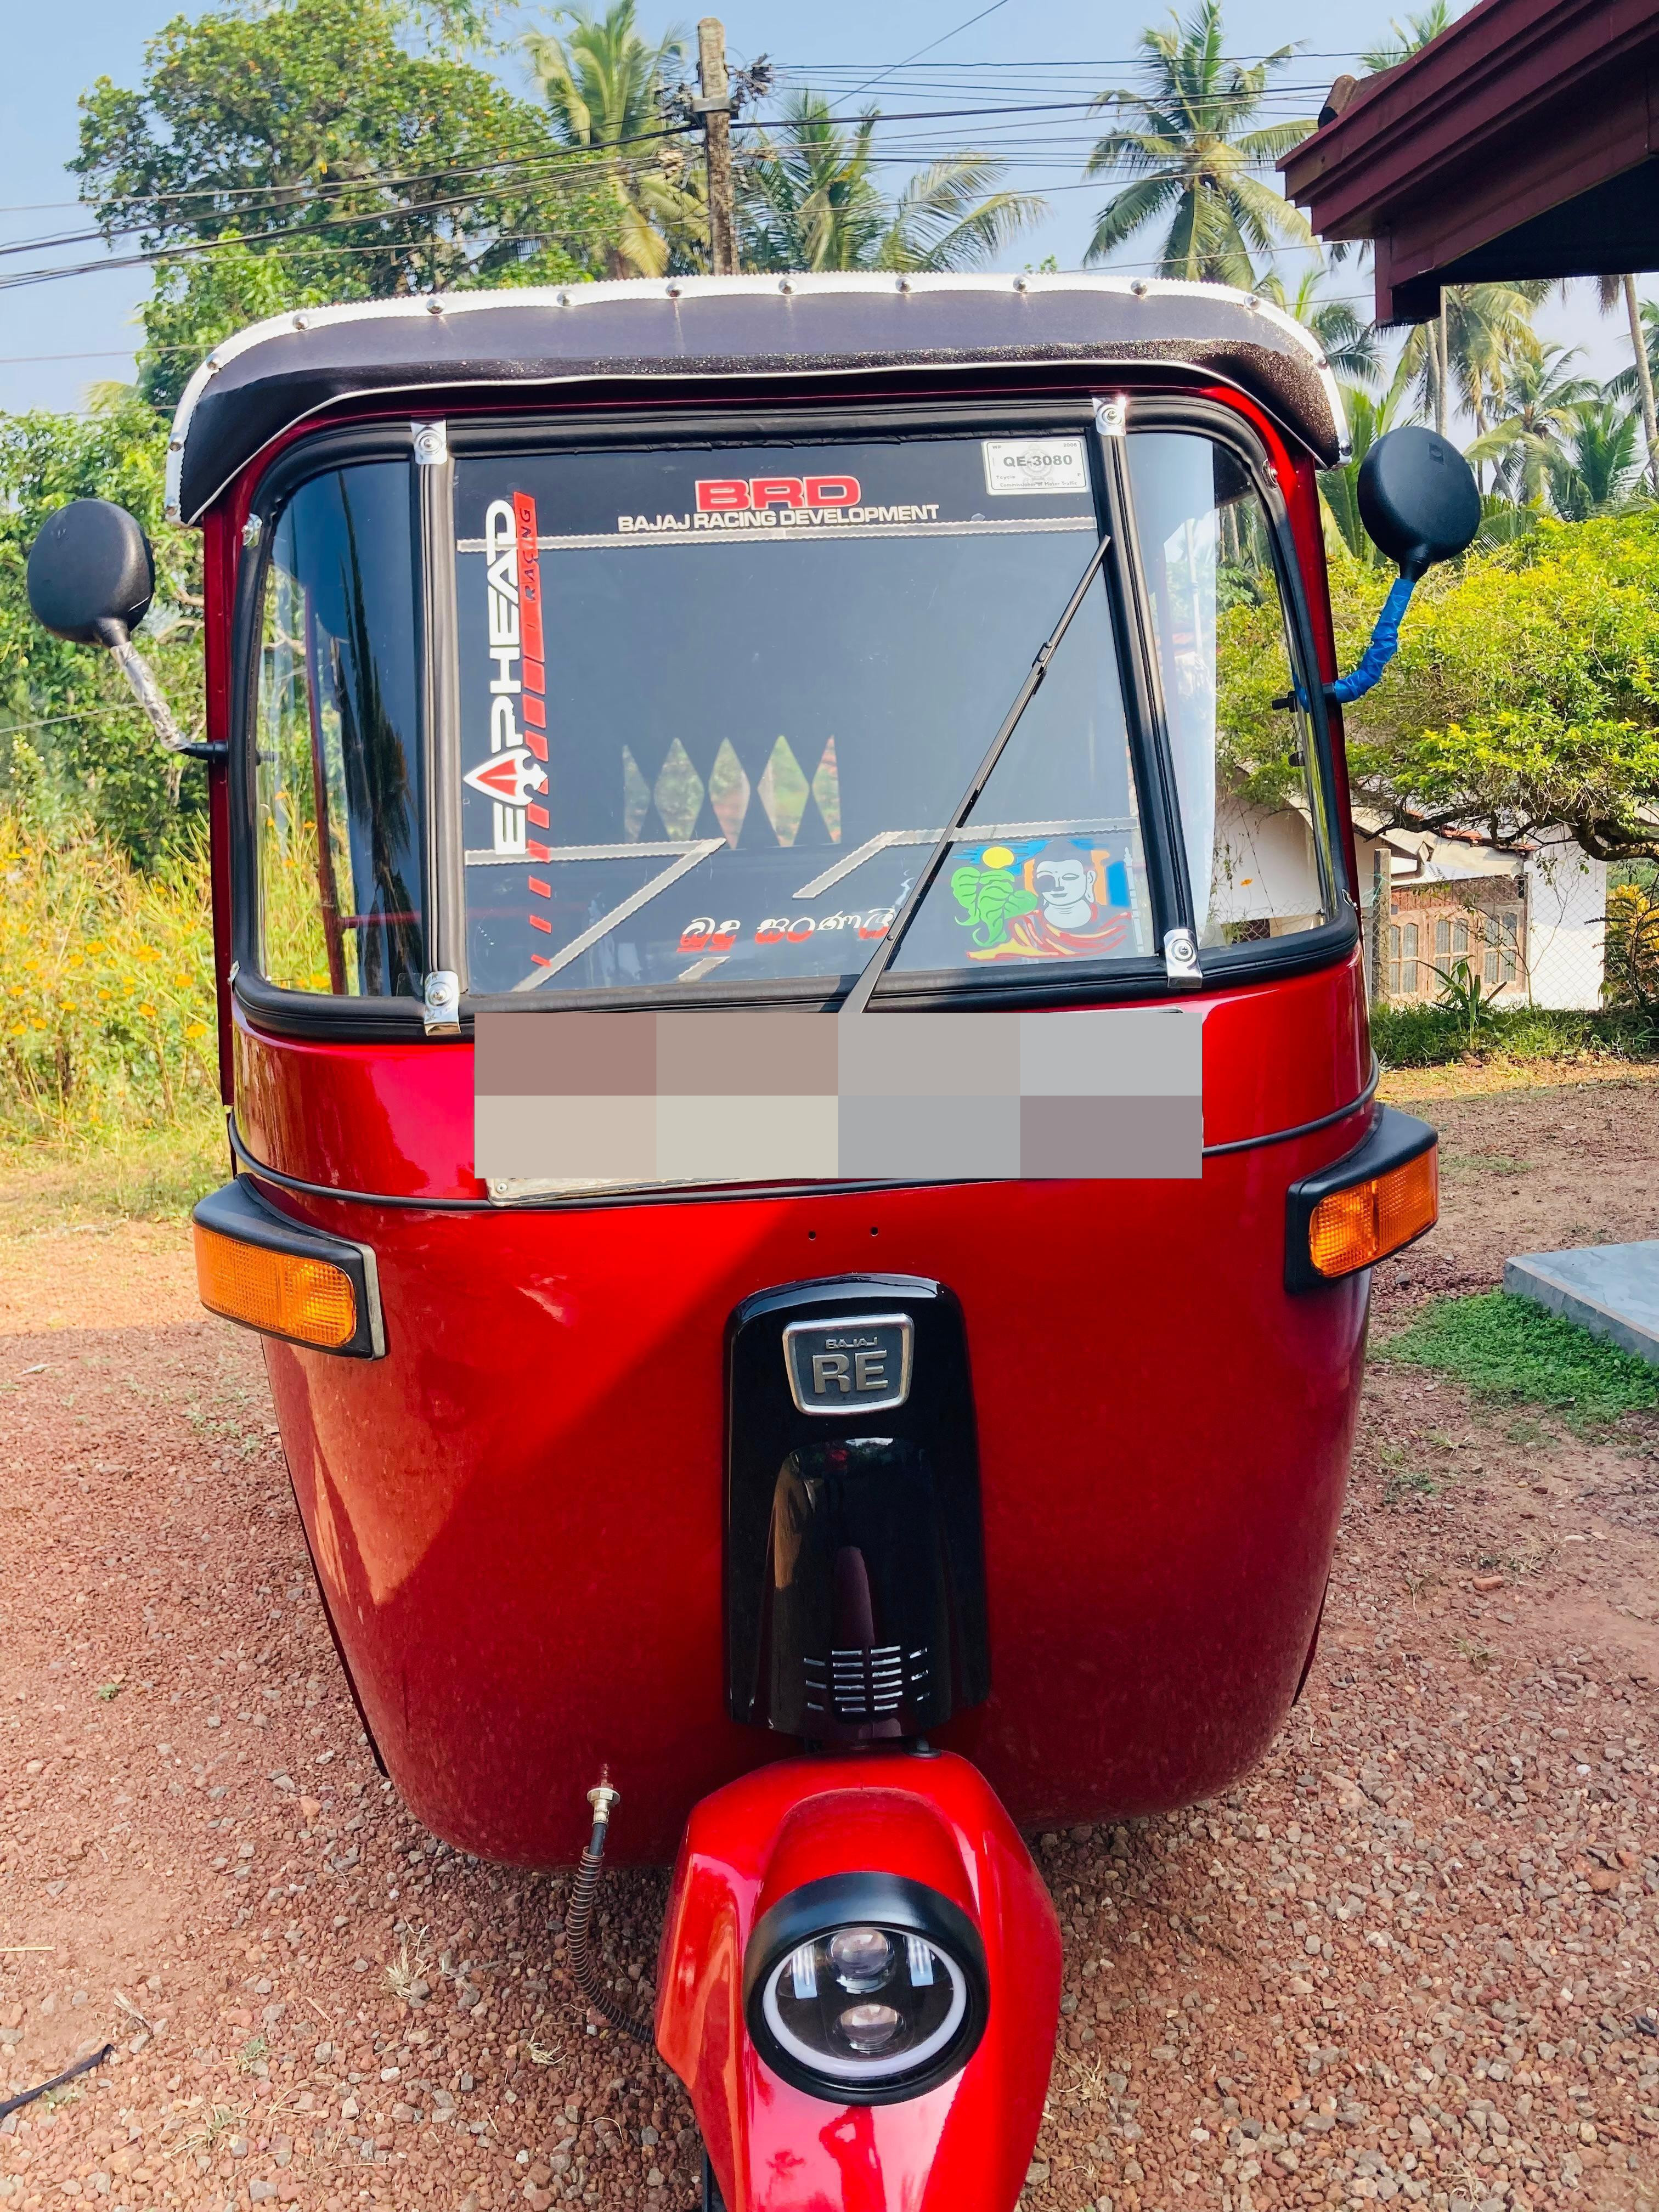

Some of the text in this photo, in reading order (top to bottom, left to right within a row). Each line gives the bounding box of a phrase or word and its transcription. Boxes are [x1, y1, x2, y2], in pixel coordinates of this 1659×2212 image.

[1003, 455, 1073, 467] QE-3080
[695, 476, 861, 512] BRD
[618, 504, 939, 532] BAJAJ RACING DEVELOPMENT
[520, 508, 537, 601] RACNG
[826, 1336, 878, 1350] BAJAJ
[812, 1350, 888, 1393] RE
